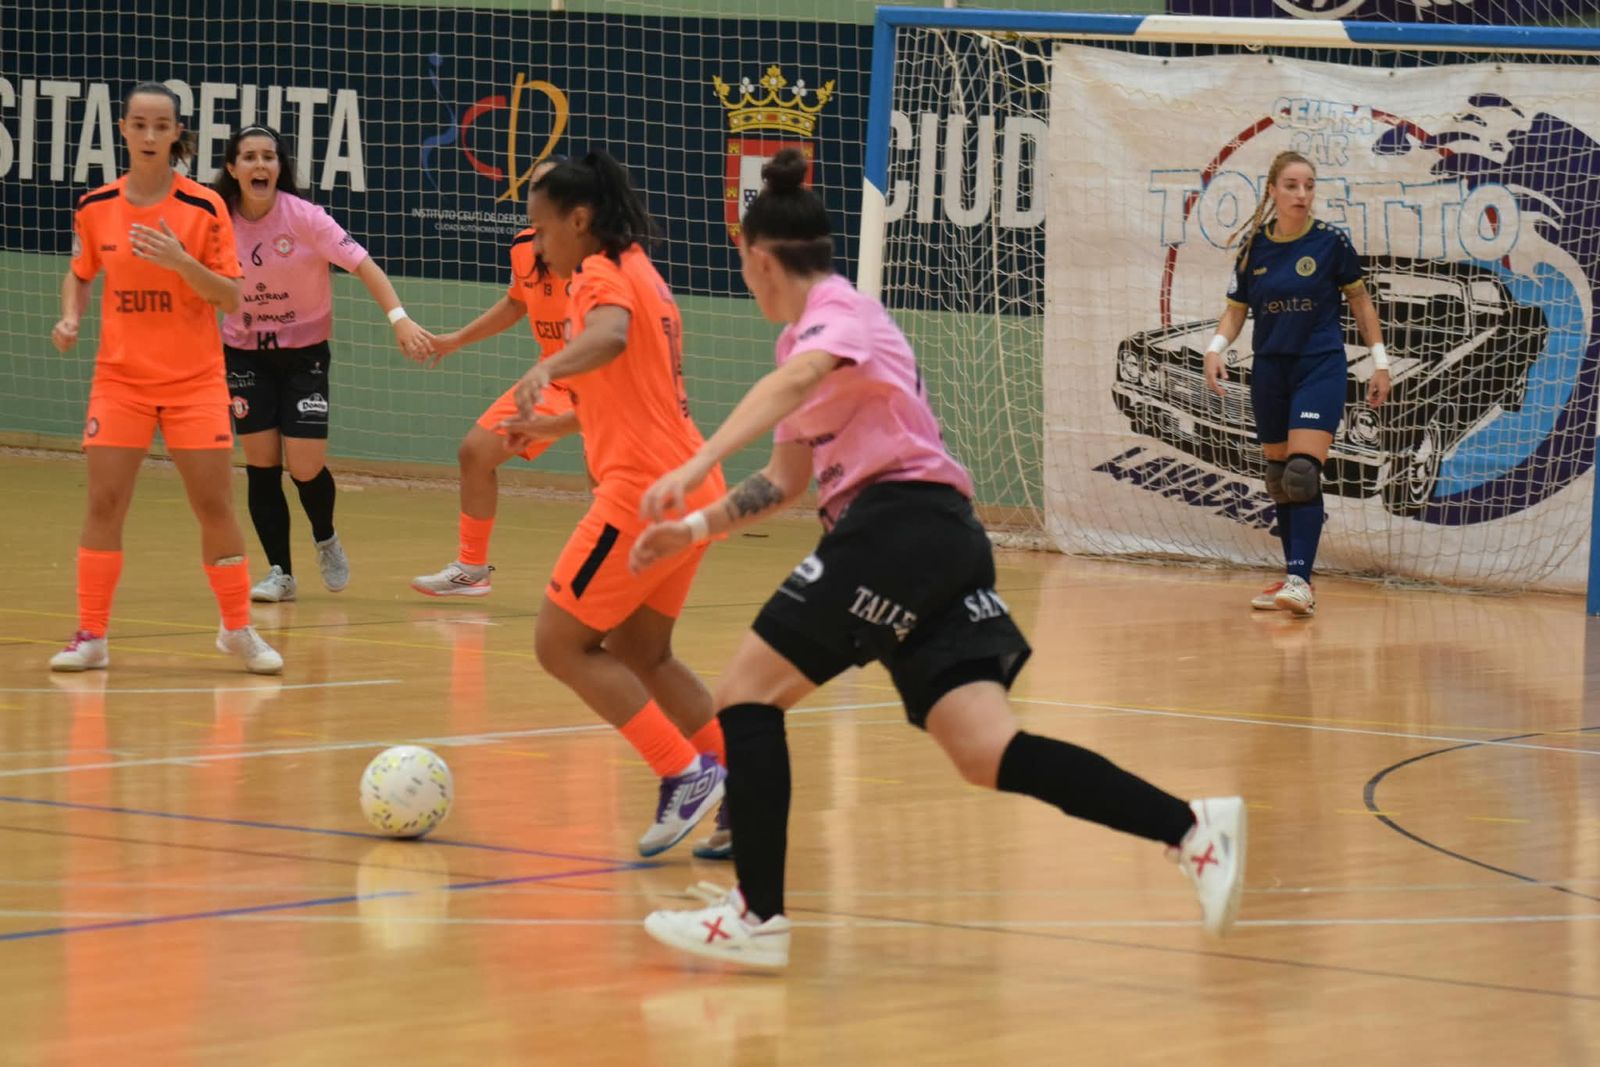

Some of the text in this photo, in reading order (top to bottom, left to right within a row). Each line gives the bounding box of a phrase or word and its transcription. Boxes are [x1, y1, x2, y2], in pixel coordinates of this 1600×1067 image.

[411, 208, 455, 220] INSTITUTO
[1149, 169, 1521, 262] TOETTO
[251, 243, 263, 267] 6
[1300, 411, 1321, 420] JAKO
[1091, 446, 1328, 537] LAVADER
